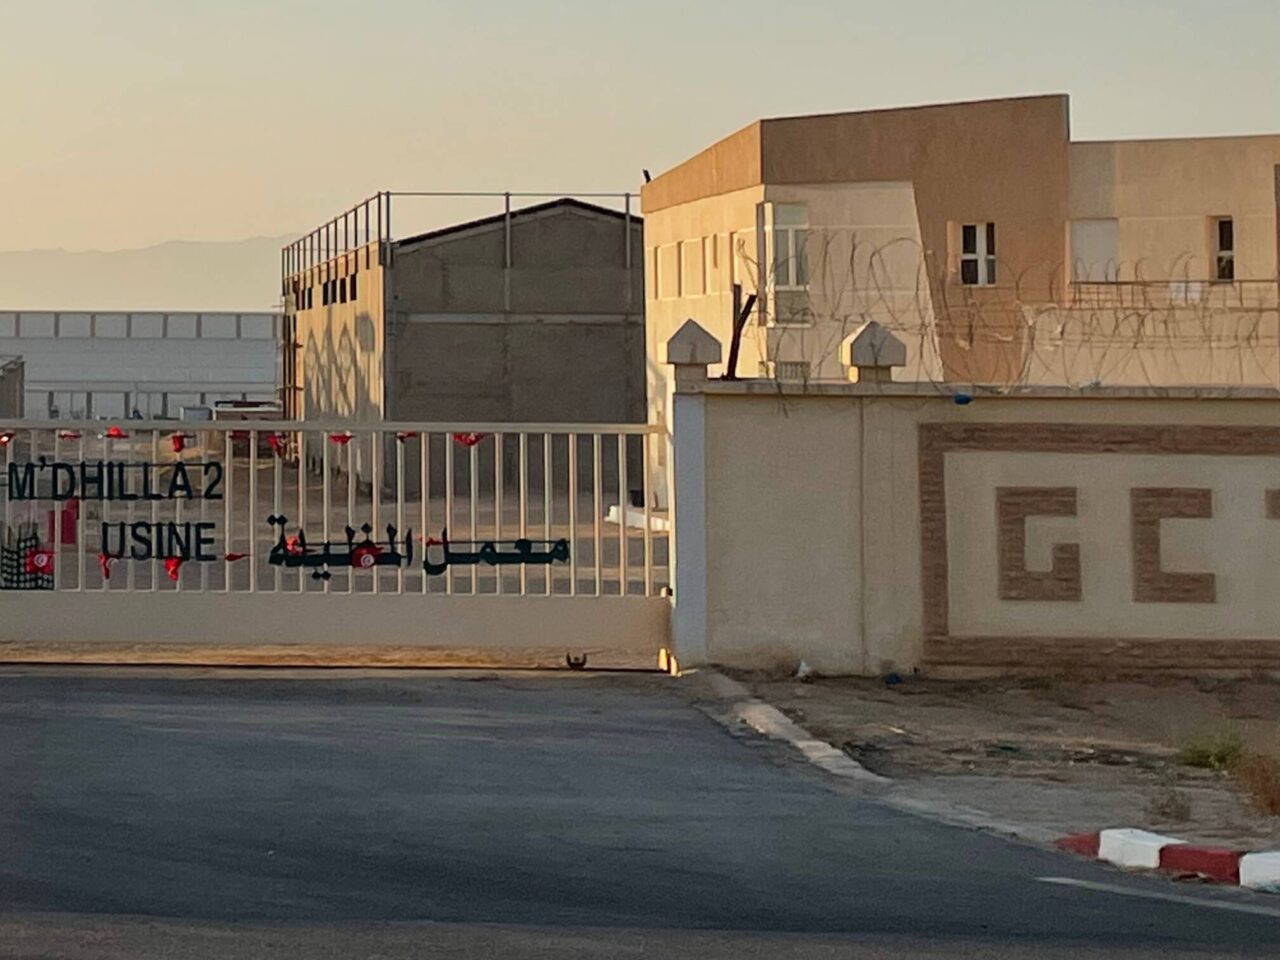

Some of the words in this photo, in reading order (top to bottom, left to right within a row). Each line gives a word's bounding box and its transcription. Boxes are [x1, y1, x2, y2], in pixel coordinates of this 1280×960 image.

[8, 456, 193, 502] M'DHILLA
[203, 461, 224, 500] 2
[102, 521, 218, 561] USINE
[423, 527, 570, 575] معمل
[995, 486, 1280, 603] GC
